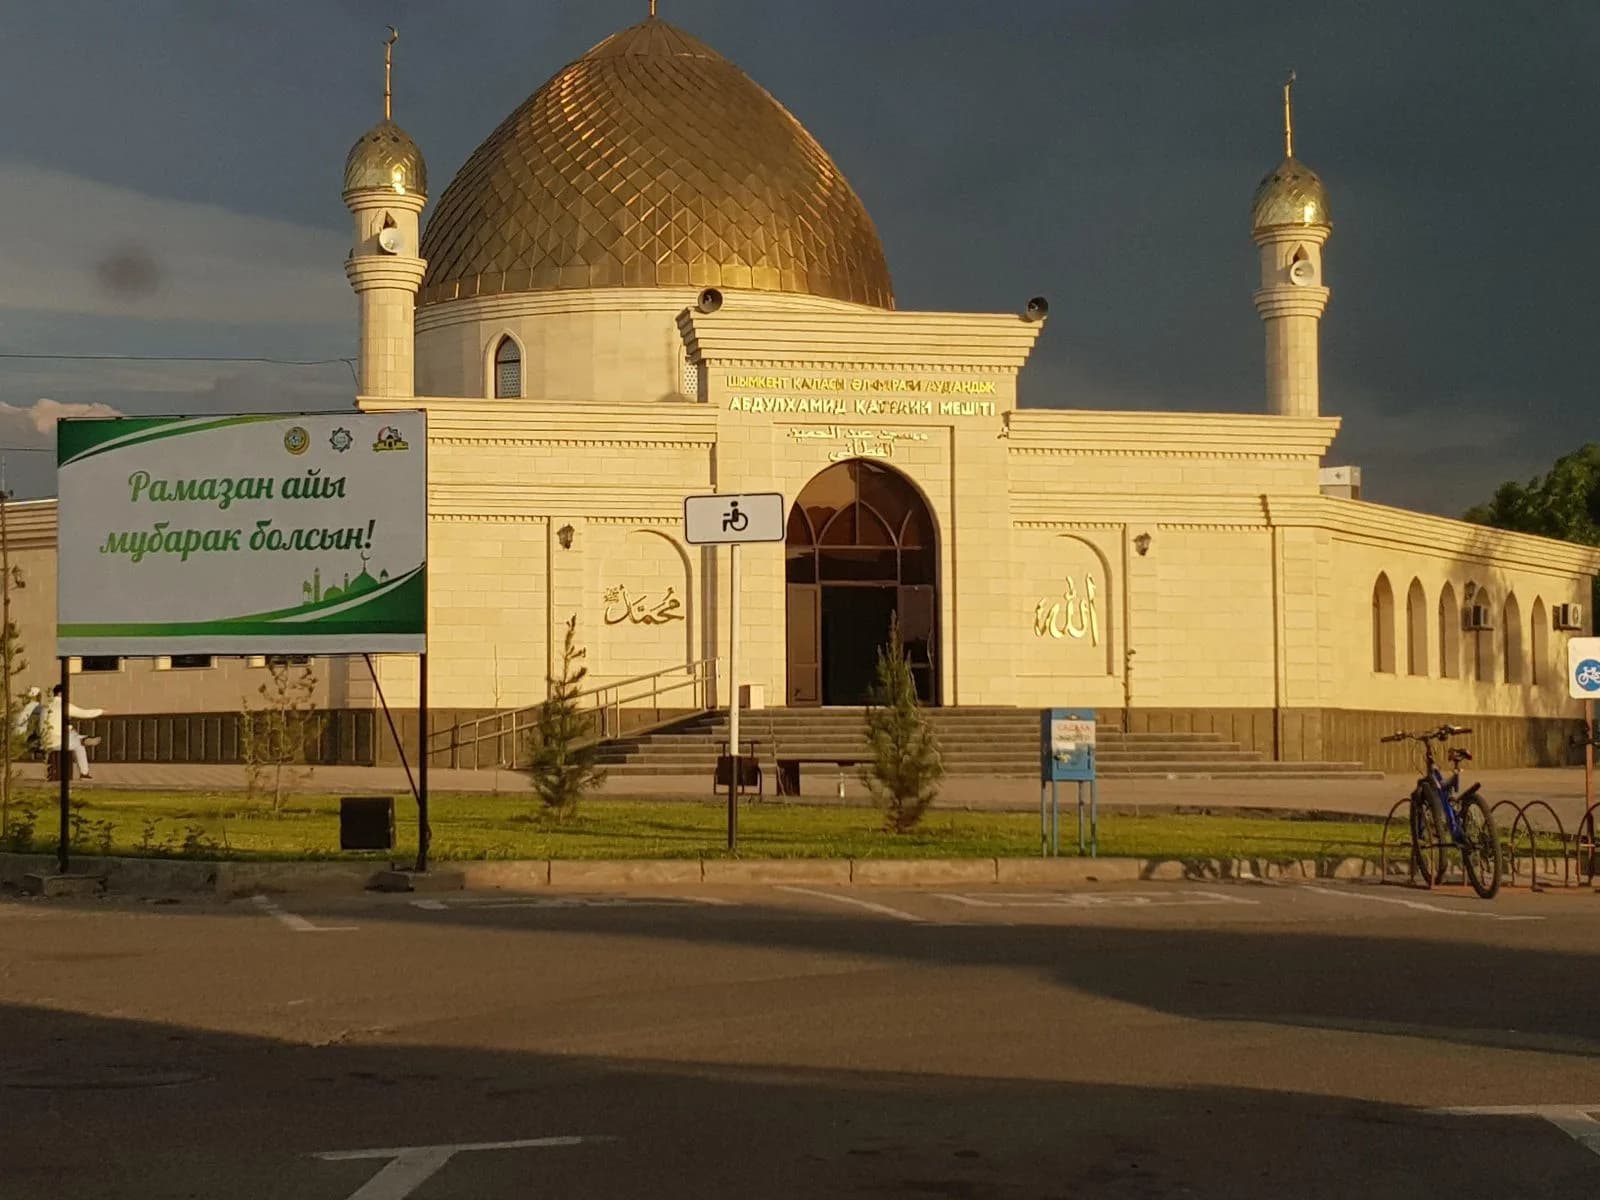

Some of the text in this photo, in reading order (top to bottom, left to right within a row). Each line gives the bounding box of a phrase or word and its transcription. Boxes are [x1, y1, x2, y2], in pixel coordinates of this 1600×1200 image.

[727, 375, 790, 389] ШЫМКЕНТ
[792, 378, 846, 392] ҚАЛАСЫ
[729, 396, 847, 414] АБДУЛХАМИД
[128, 469, 346, 510] Рамазан айы
[100, 519, 376, 563] мубарак болсын!
